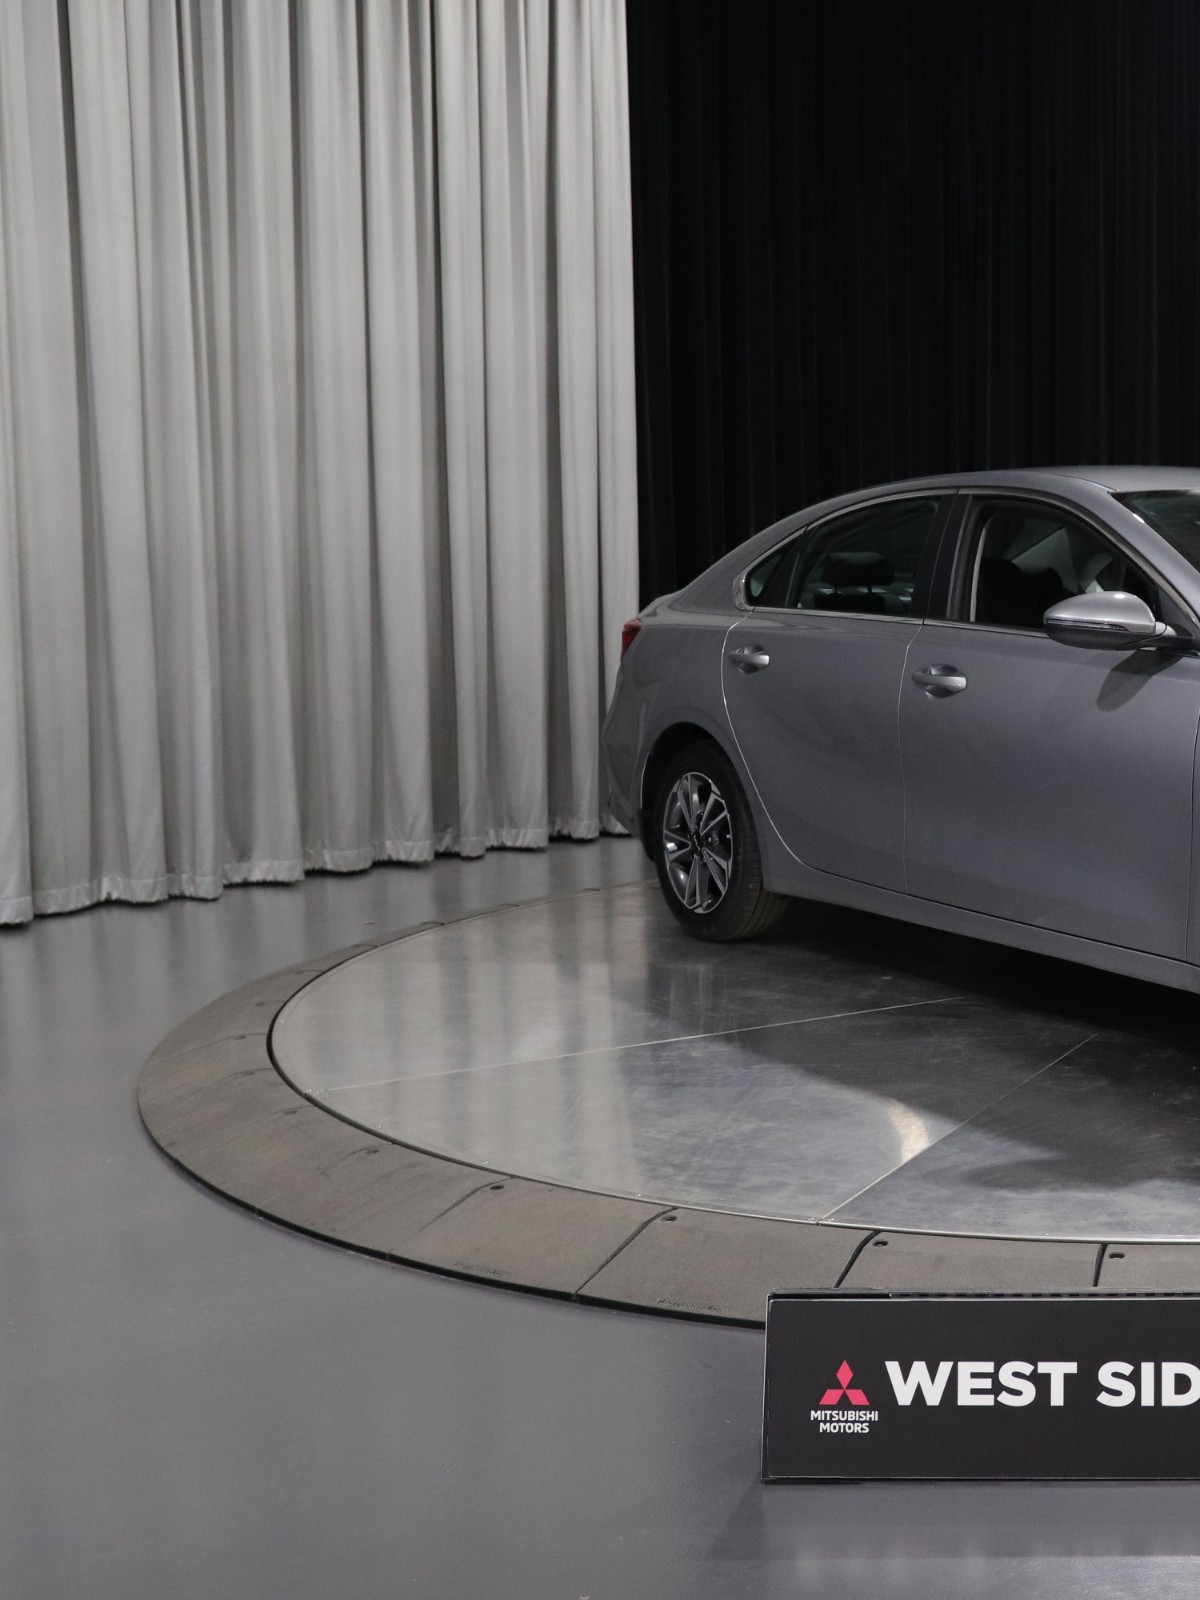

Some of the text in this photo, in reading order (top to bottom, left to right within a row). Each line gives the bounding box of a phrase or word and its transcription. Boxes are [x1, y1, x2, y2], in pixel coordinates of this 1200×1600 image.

[885, 1361, 1078, 1407] WEST
[810, 1410, 879, 1422] MITSUBISHI
[819, 1422, 870, 1434] MOTORS
